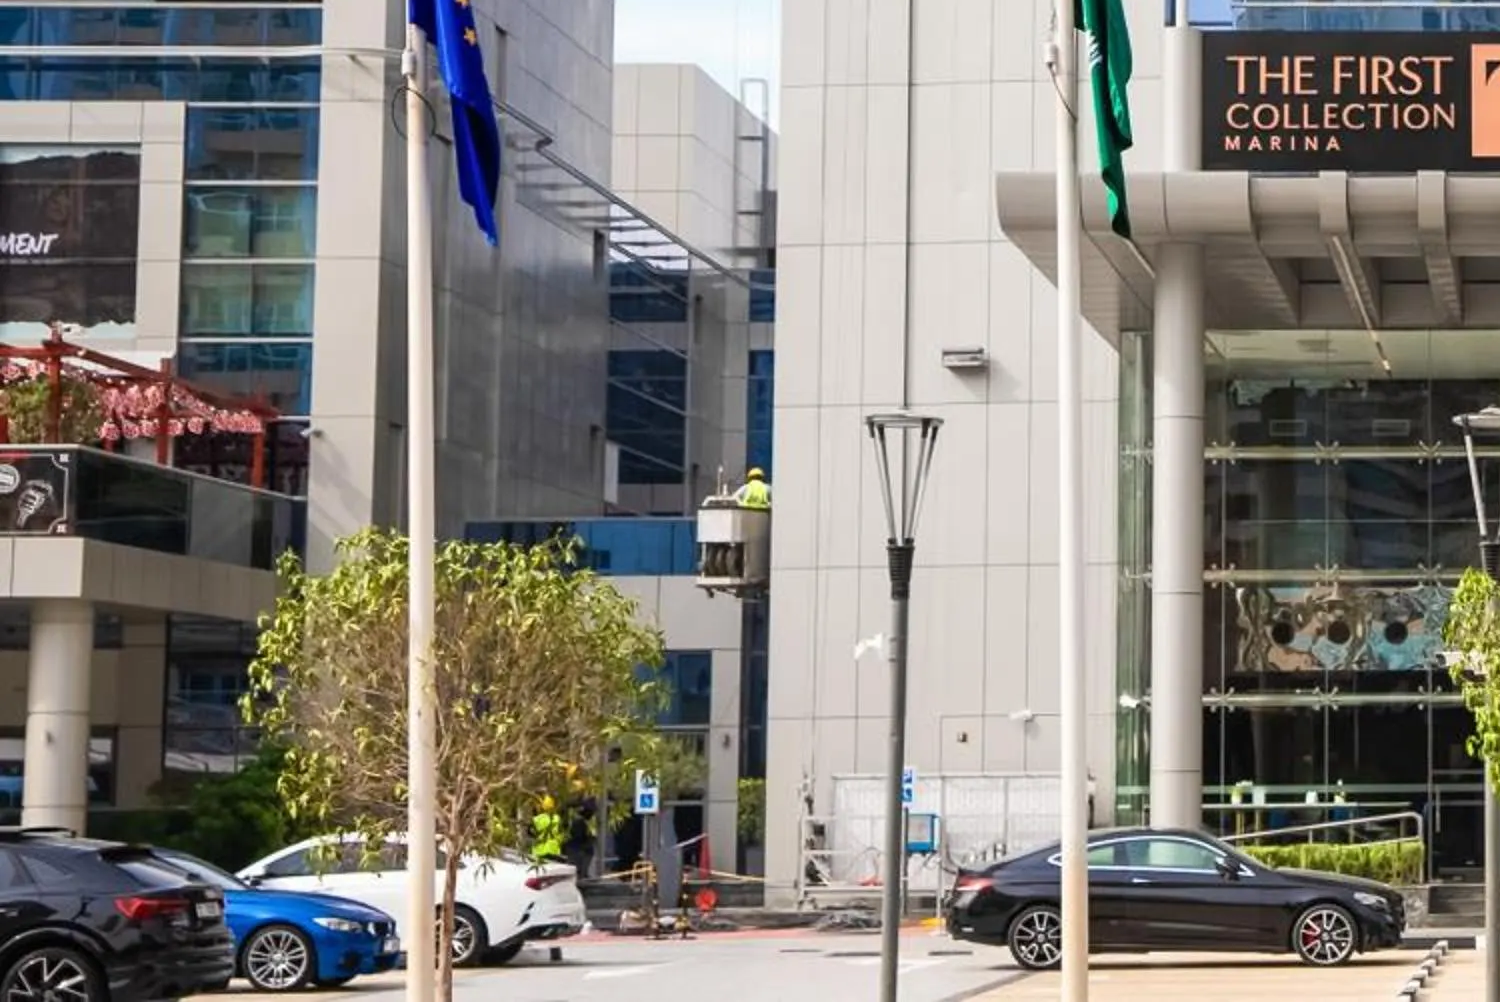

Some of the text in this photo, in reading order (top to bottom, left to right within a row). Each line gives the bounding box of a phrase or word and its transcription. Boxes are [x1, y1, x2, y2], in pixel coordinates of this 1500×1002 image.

[1225, 55, 1455, 96] THE FIRST
[1225, 102, 1456, 130] COLLECTION
[1224, 135, 1341, 151] MARINA
